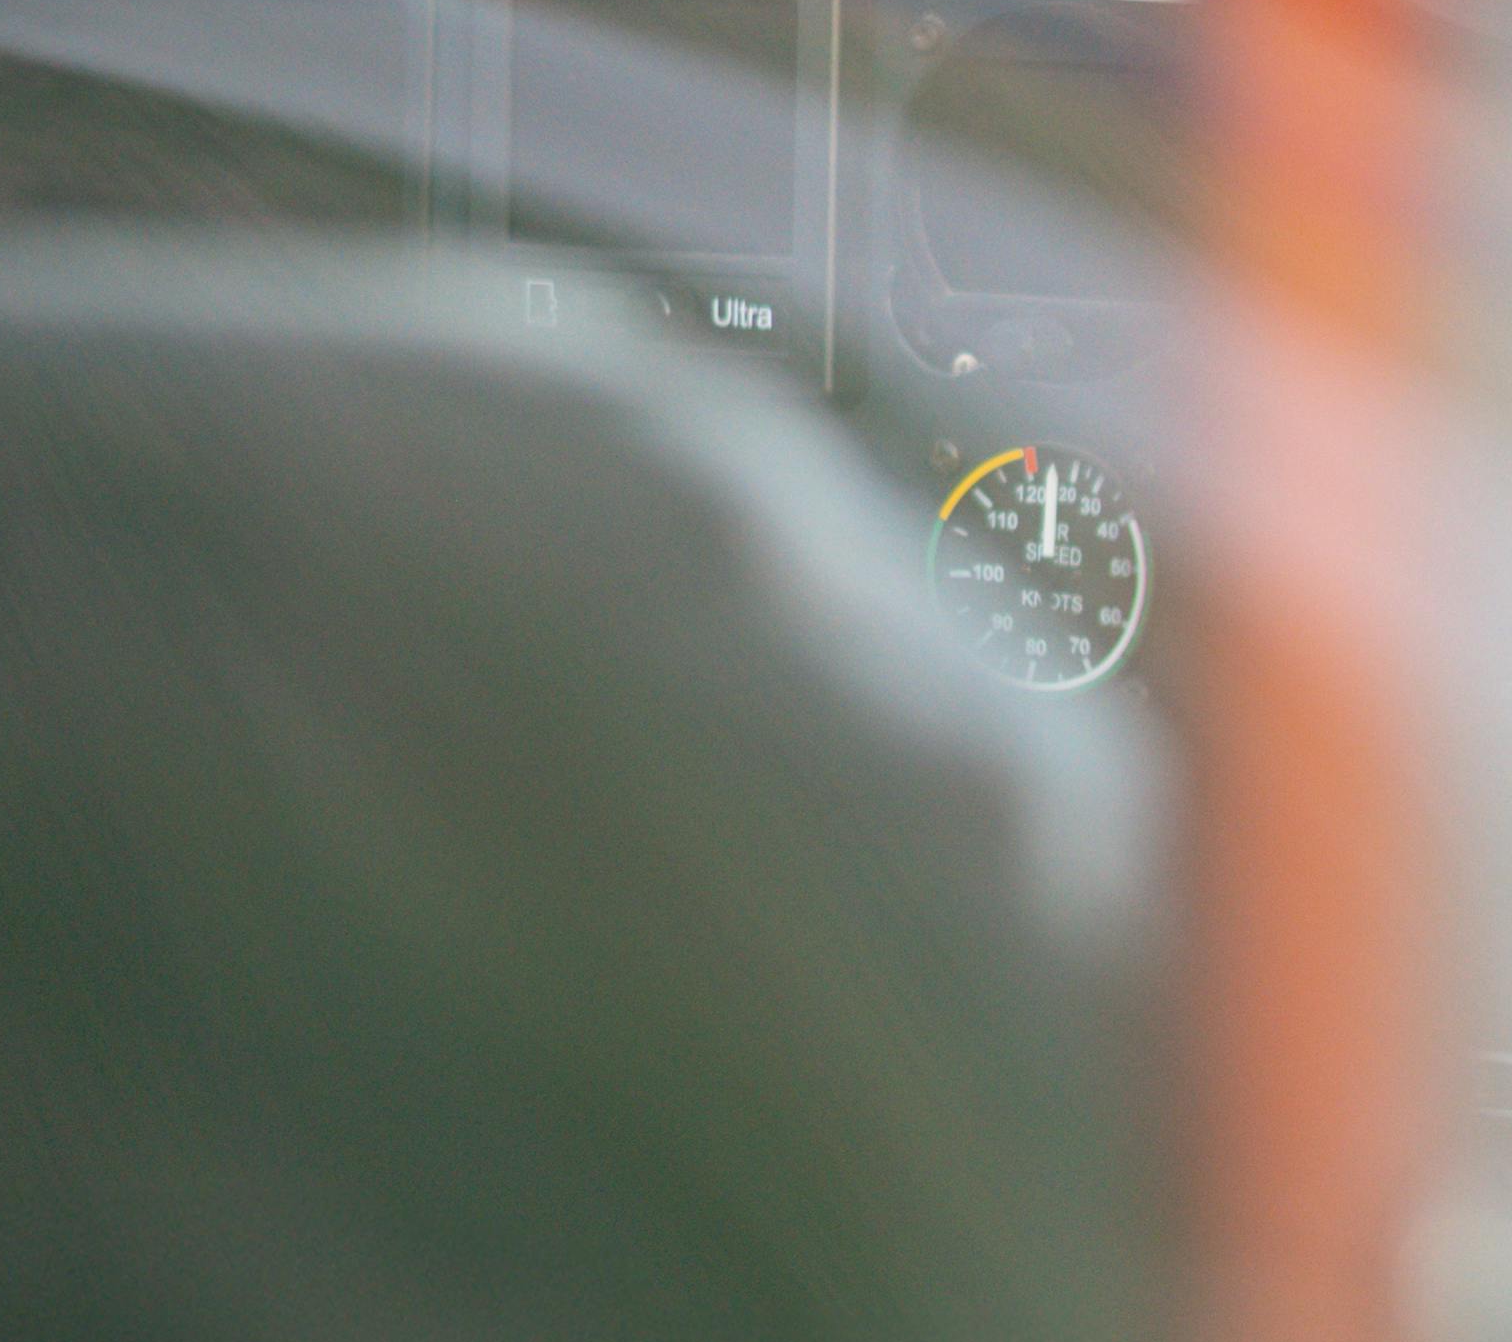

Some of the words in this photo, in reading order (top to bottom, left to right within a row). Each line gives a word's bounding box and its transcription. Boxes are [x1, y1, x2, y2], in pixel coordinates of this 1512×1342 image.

[711, 297, 773, 330] Ultra
[988, 512, 1018, 530] 110
[1097, 522, 1119, 540] 40
[1026, 542, 1082, 566] SED
[973, 564, 1004, 582] 100
[1100, 608, 1123, 626] 60
[1069, 636, 1091, 655] 70
